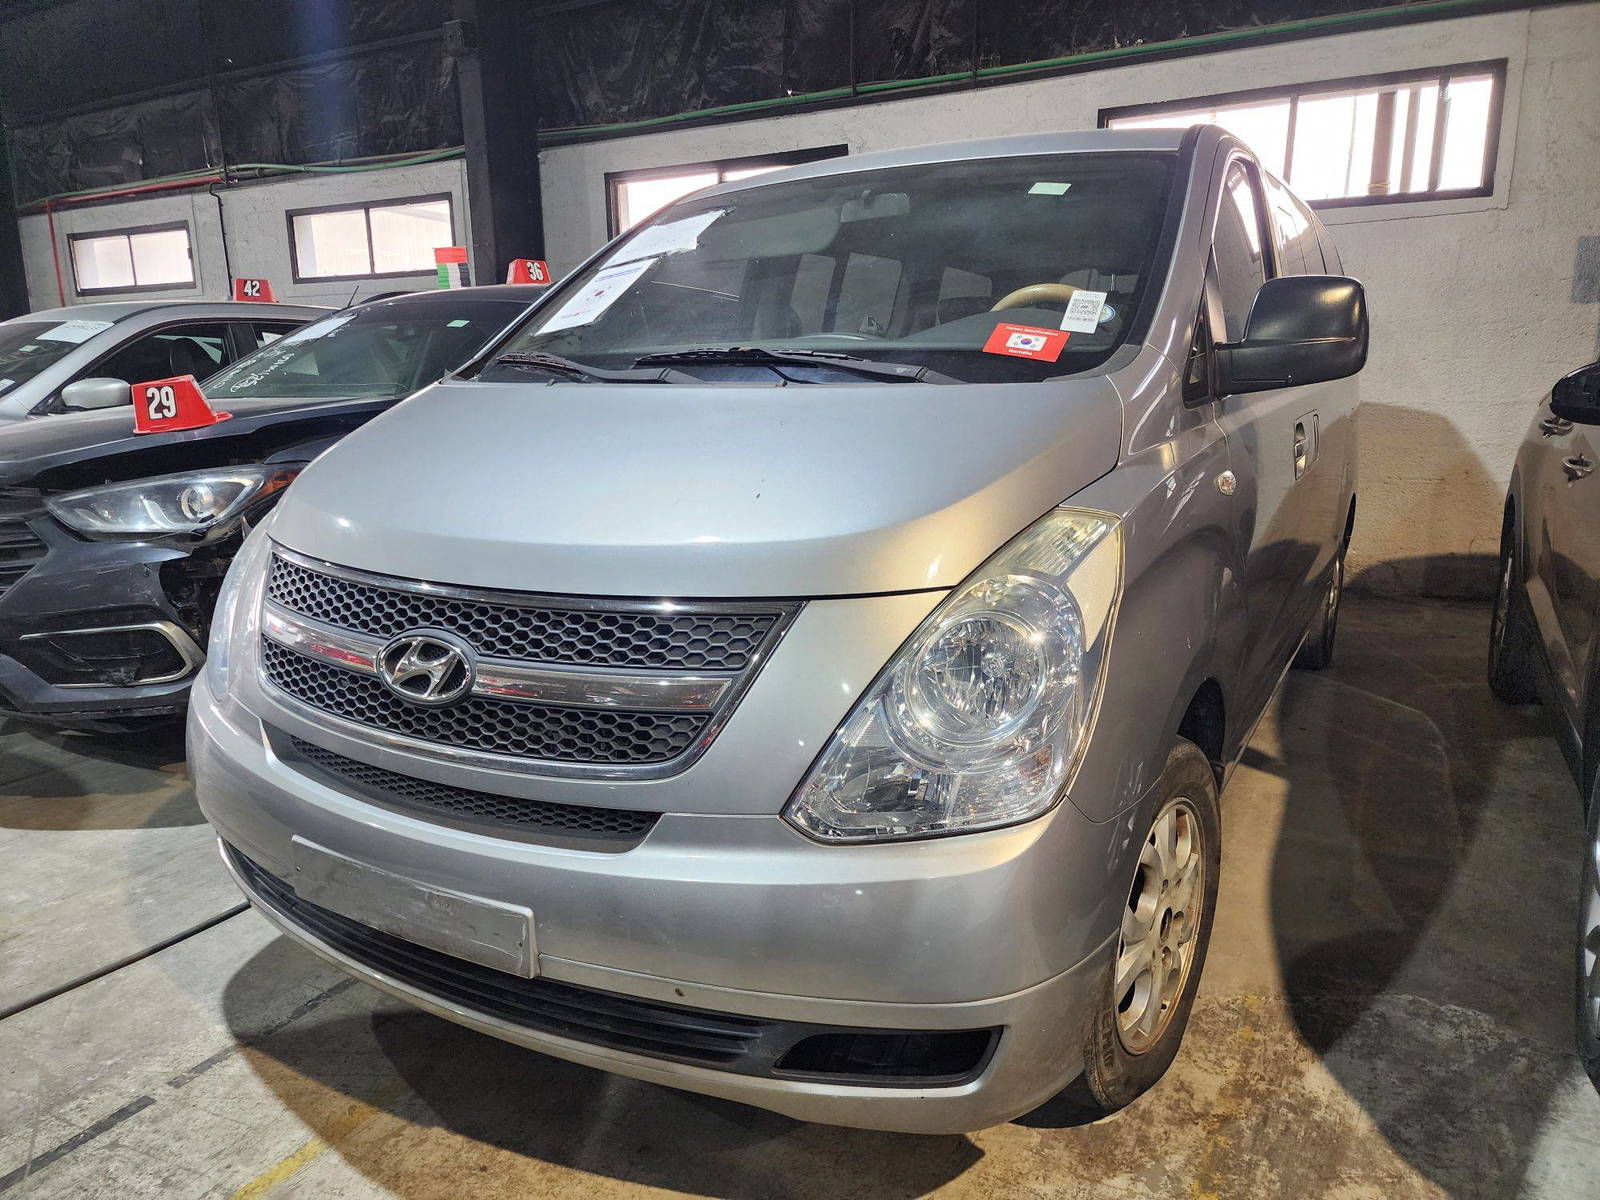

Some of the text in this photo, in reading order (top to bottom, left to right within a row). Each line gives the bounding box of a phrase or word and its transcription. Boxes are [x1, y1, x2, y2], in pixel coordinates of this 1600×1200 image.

[526, 261, 544, 280] 36
[244, 280, 260, 296] 42
[146, 386, 177, 419] 29
